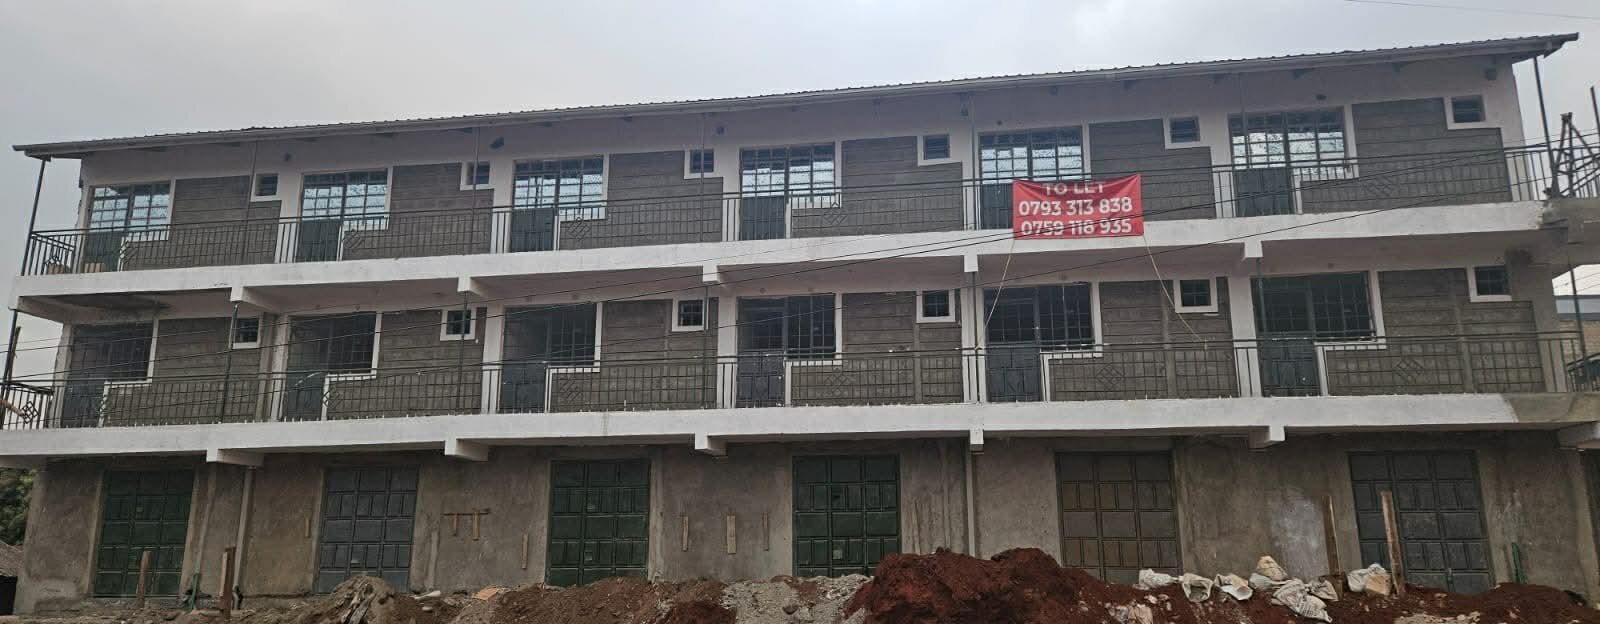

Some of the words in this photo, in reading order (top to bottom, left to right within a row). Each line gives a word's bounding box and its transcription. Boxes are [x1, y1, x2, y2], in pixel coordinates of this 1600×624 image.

[1043, 182, 1068, 196] TO
[1074, 182, 1105, 194] LET
[1019, 201, 1062, 216] 0793
[1066, 199, 1094, 216] 313
[1099, 197, 1133, 214] 838
[1021, 221, 1064, 236] 0759
[1071, 220, 1095, 235] 118
[1100, 218, 1132, 234] 935
